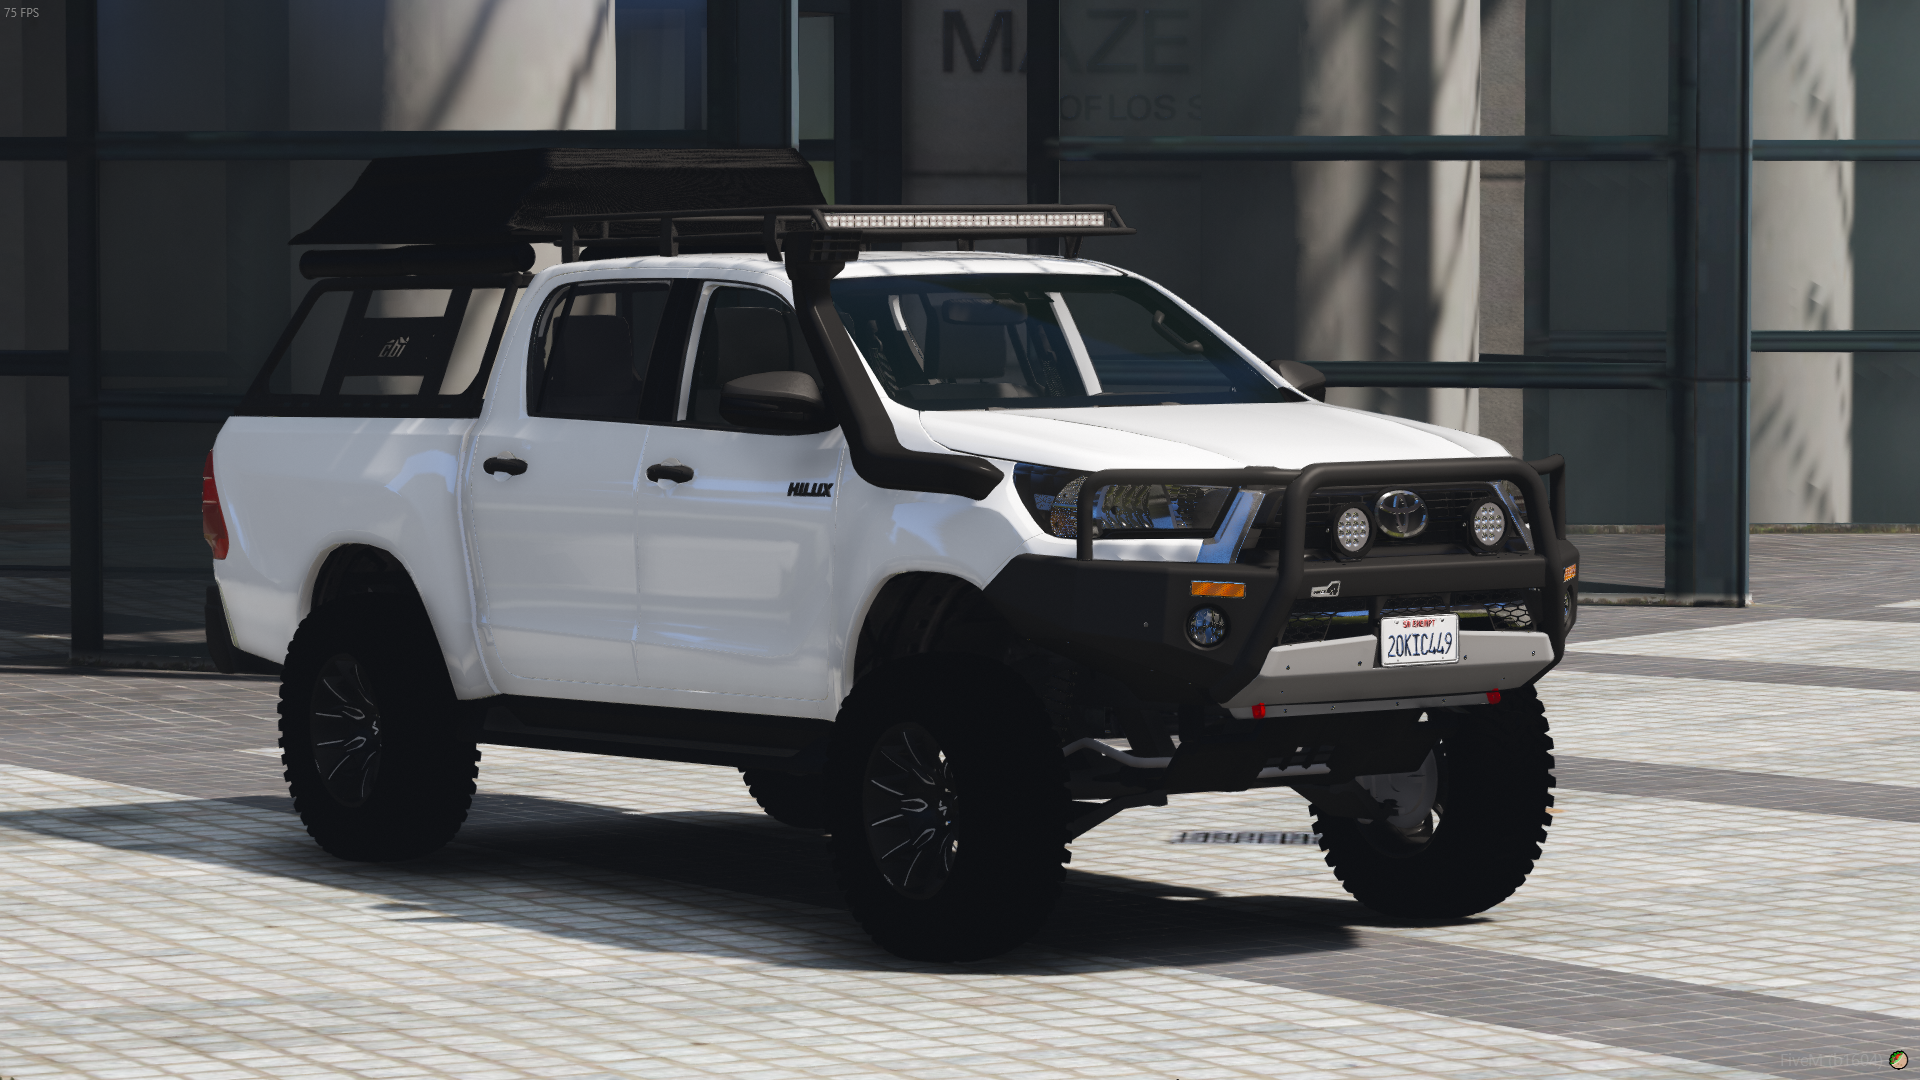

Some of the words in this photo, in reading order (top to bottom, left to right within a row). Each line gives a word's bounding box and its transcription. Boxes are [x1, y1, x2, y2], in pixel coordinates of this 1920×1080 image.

[1060, 94, 1103, 121] OF
[1109, 94, 1176, 121] LOS
[787, 482, 834, 498] HILUX
[1412, 619, 1436, 628] EXEMPT
[1388, 631, 1453, 658] 20KIC449
